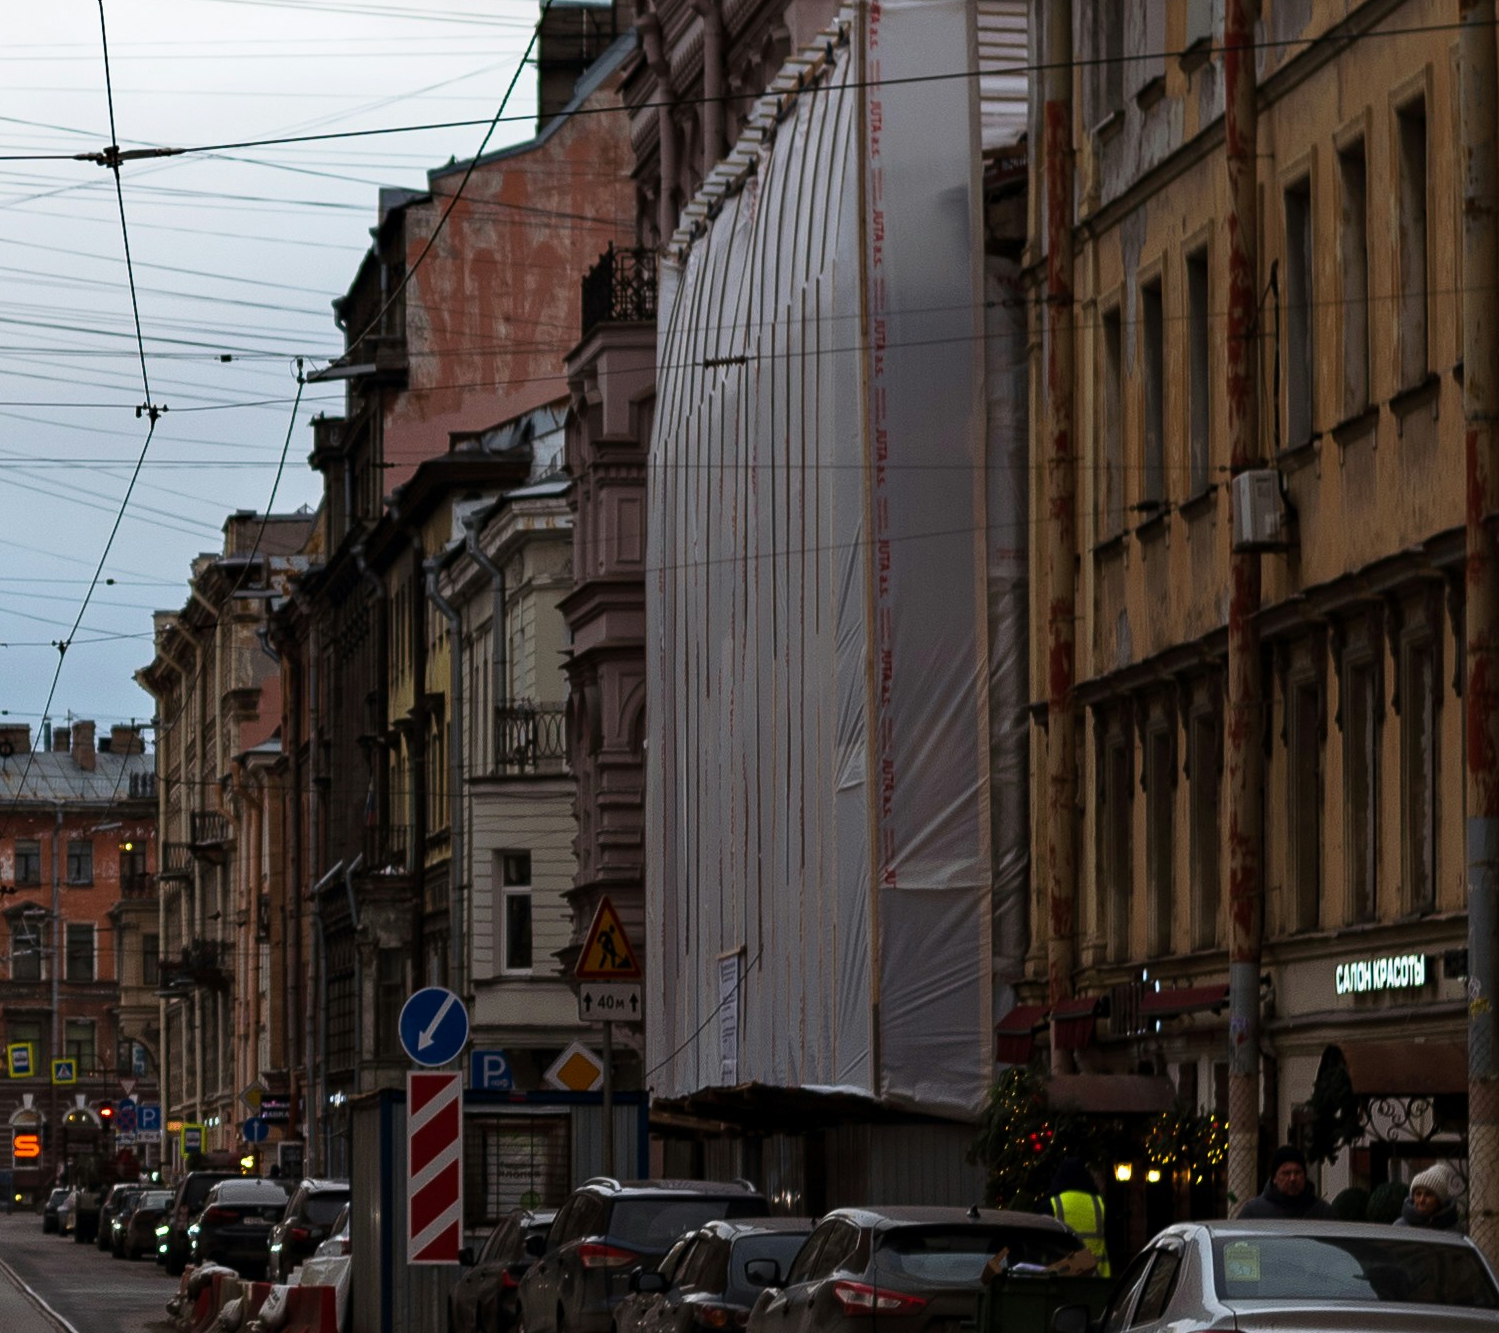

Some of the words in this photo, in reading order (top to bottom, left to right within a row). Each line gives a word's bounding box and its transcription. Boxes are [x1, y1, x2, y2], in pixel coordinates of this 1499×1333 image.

[872, 209, 884, 242] JUTA
[874, 318, 886, 351] JUTA
[876, 428, 887, 461] JUTA
[879, 538, 890, 571] JUTA
[1335, 959, 1372, 995] САЛОН
[1373, 953, 1425, 990] КРАСОТЫ
